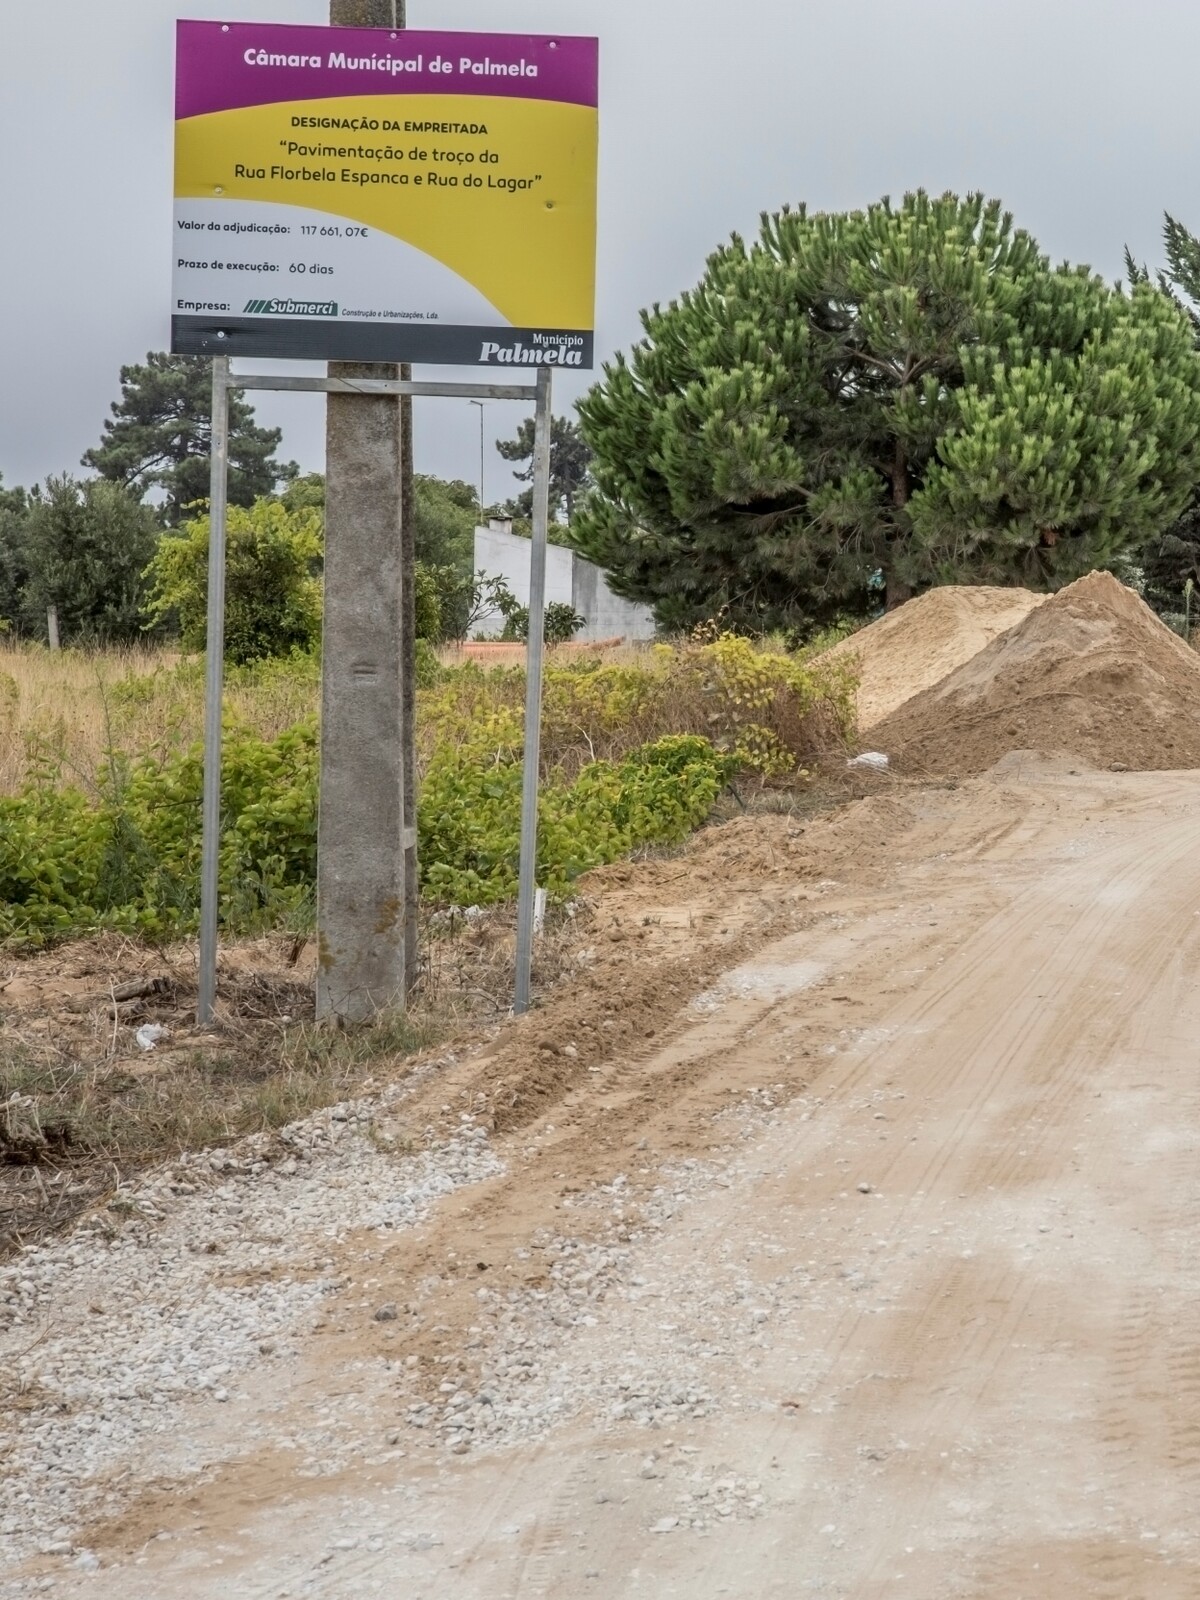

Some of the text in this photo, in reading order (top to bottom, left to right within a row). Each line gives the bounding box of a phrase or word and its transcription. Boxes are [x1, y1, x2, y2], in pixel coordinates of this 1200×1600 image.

[244, 48, 321, 68] Câmara
[429, 55, 453, 73] de
[459, 57, 538, 77] Palmela
[291, 116, 488, 135] DESIGNAÇÃO DA EMPREITADA
[408, 147, 428, 161] de
[432, 149, 475, 165] troço
[479, 149, 499, 163] da
[235, 165, 265, 179] Rua
[270, 166, 336, 182] Florbela
[341, 169, 409, 187] Espanca
[413, 175, 423, 185] e
[427, 172, 457, 187] Rua
[462, 173, 483, 188] do
[177, 220, 369, 238] Valor da adjudicação: 117 661, 07€
[177, 258, 334, 275] Prazo de execução: 60 dias
[177, 298, 334, 315] Empresa: Submerci
[532, 333, 584, 348] Município
[479, 341, 583, 365] Palmela
